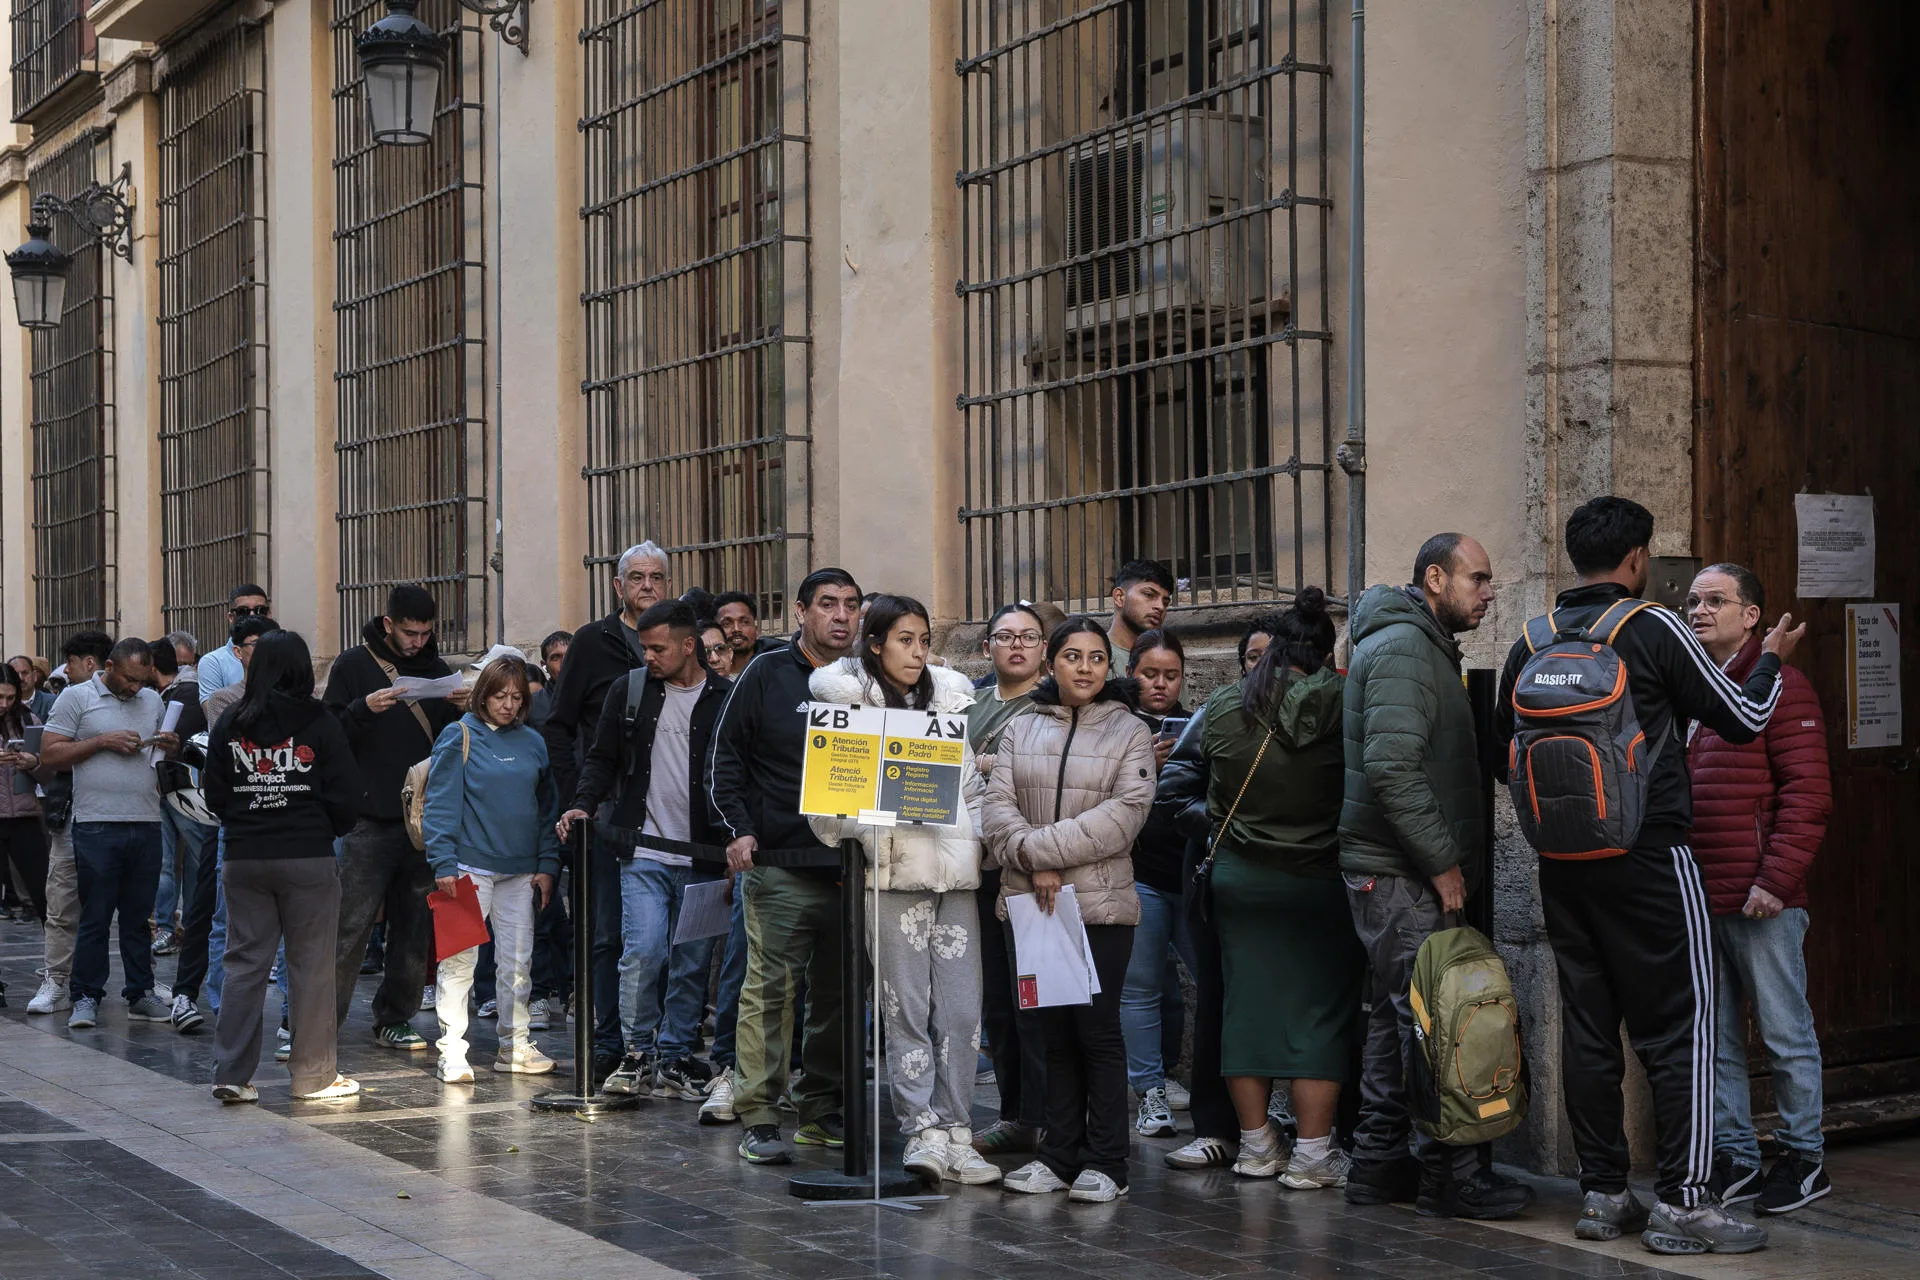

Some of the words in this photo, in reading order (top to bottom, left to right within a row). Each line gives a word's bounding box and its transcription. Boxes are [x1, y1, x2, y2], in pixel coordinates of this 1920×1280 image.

[1857, 616, 1870, 625] Taxa
[1871, 616, 1878, 625] de
[1858, 639, 1872, 648] Tasa
[1872, 638, 1880, 647] de
[833, 709, 849, 729] B
[925, 718, 943, 737] A
[832, 736, 868, 746] Atención
[909, 741, 938, 751] Padrón
[832, 744, 870, 754] Tributaria
[908, 749, 932, 758] Padró
[830, 765, 861, 775] Atenció
[889, 767, 898, 778] 2
[830, 773, 867, 783] Tributària
